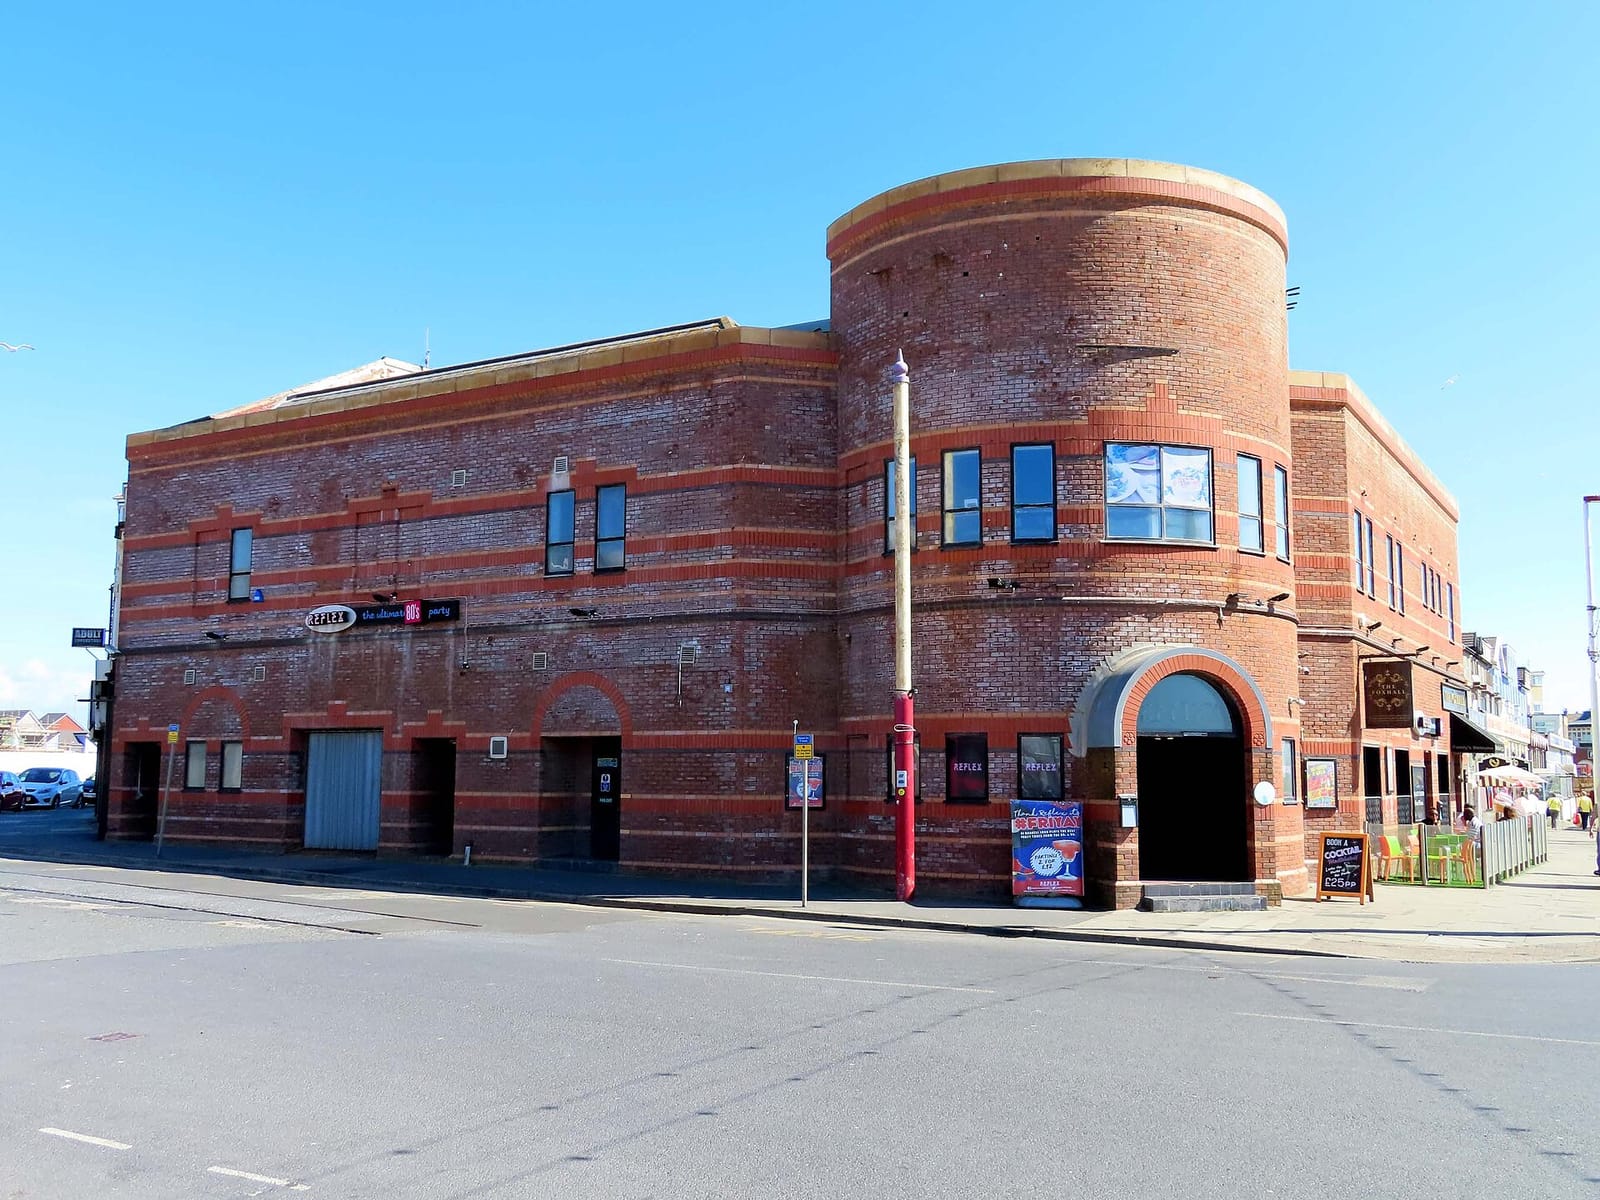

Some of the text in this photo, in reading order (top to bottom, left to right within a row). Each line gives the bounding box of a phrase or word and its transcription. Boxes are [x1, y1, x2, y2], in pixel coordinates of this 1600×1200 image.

[307, 611, 344, 625] REFLEX
[363, 610, 374, 620] the
[406, 604, 419, 621] 80's
[429, 607, 450, 618] party
[953, 763, 982, 771] REFLEX
[1025, 763, 1056, 772] REFLEX
[1324, 846, 1362, 859] COCKTAIL
